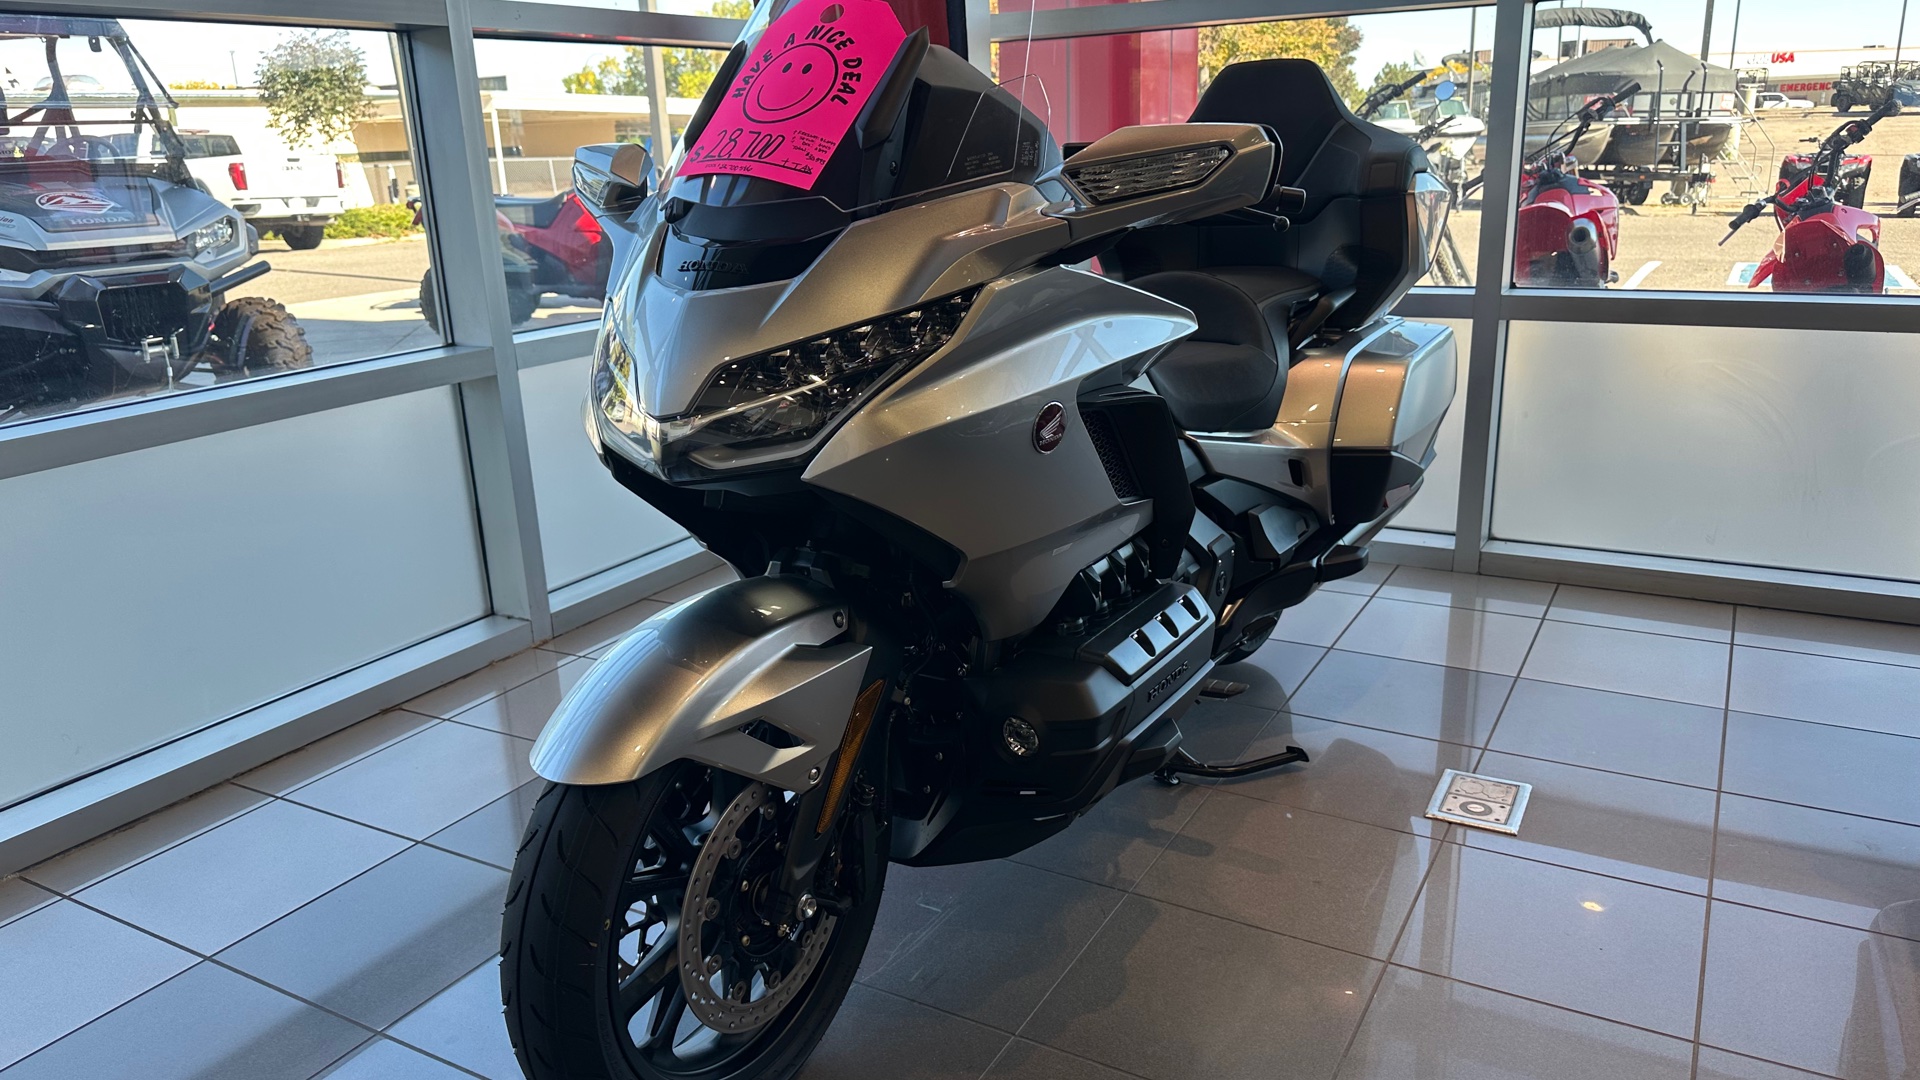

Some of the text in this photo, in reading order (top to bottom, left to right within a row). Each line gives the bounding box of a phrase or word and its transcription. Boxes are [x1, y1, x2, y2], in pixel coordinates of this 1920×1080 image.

[1771, 52, 1795, 63] USA
[732, 25, 863, 105] HAVE A NICE DEAL
[1780, 82, 1832, 92] EMERGENC
[69, 216, 130, 225] HONDA
[677, 260, 749, 274] HONDA
[1039, 433, 1062, 446] HONDA
[1147, 660, 1188, 703] HONDA
